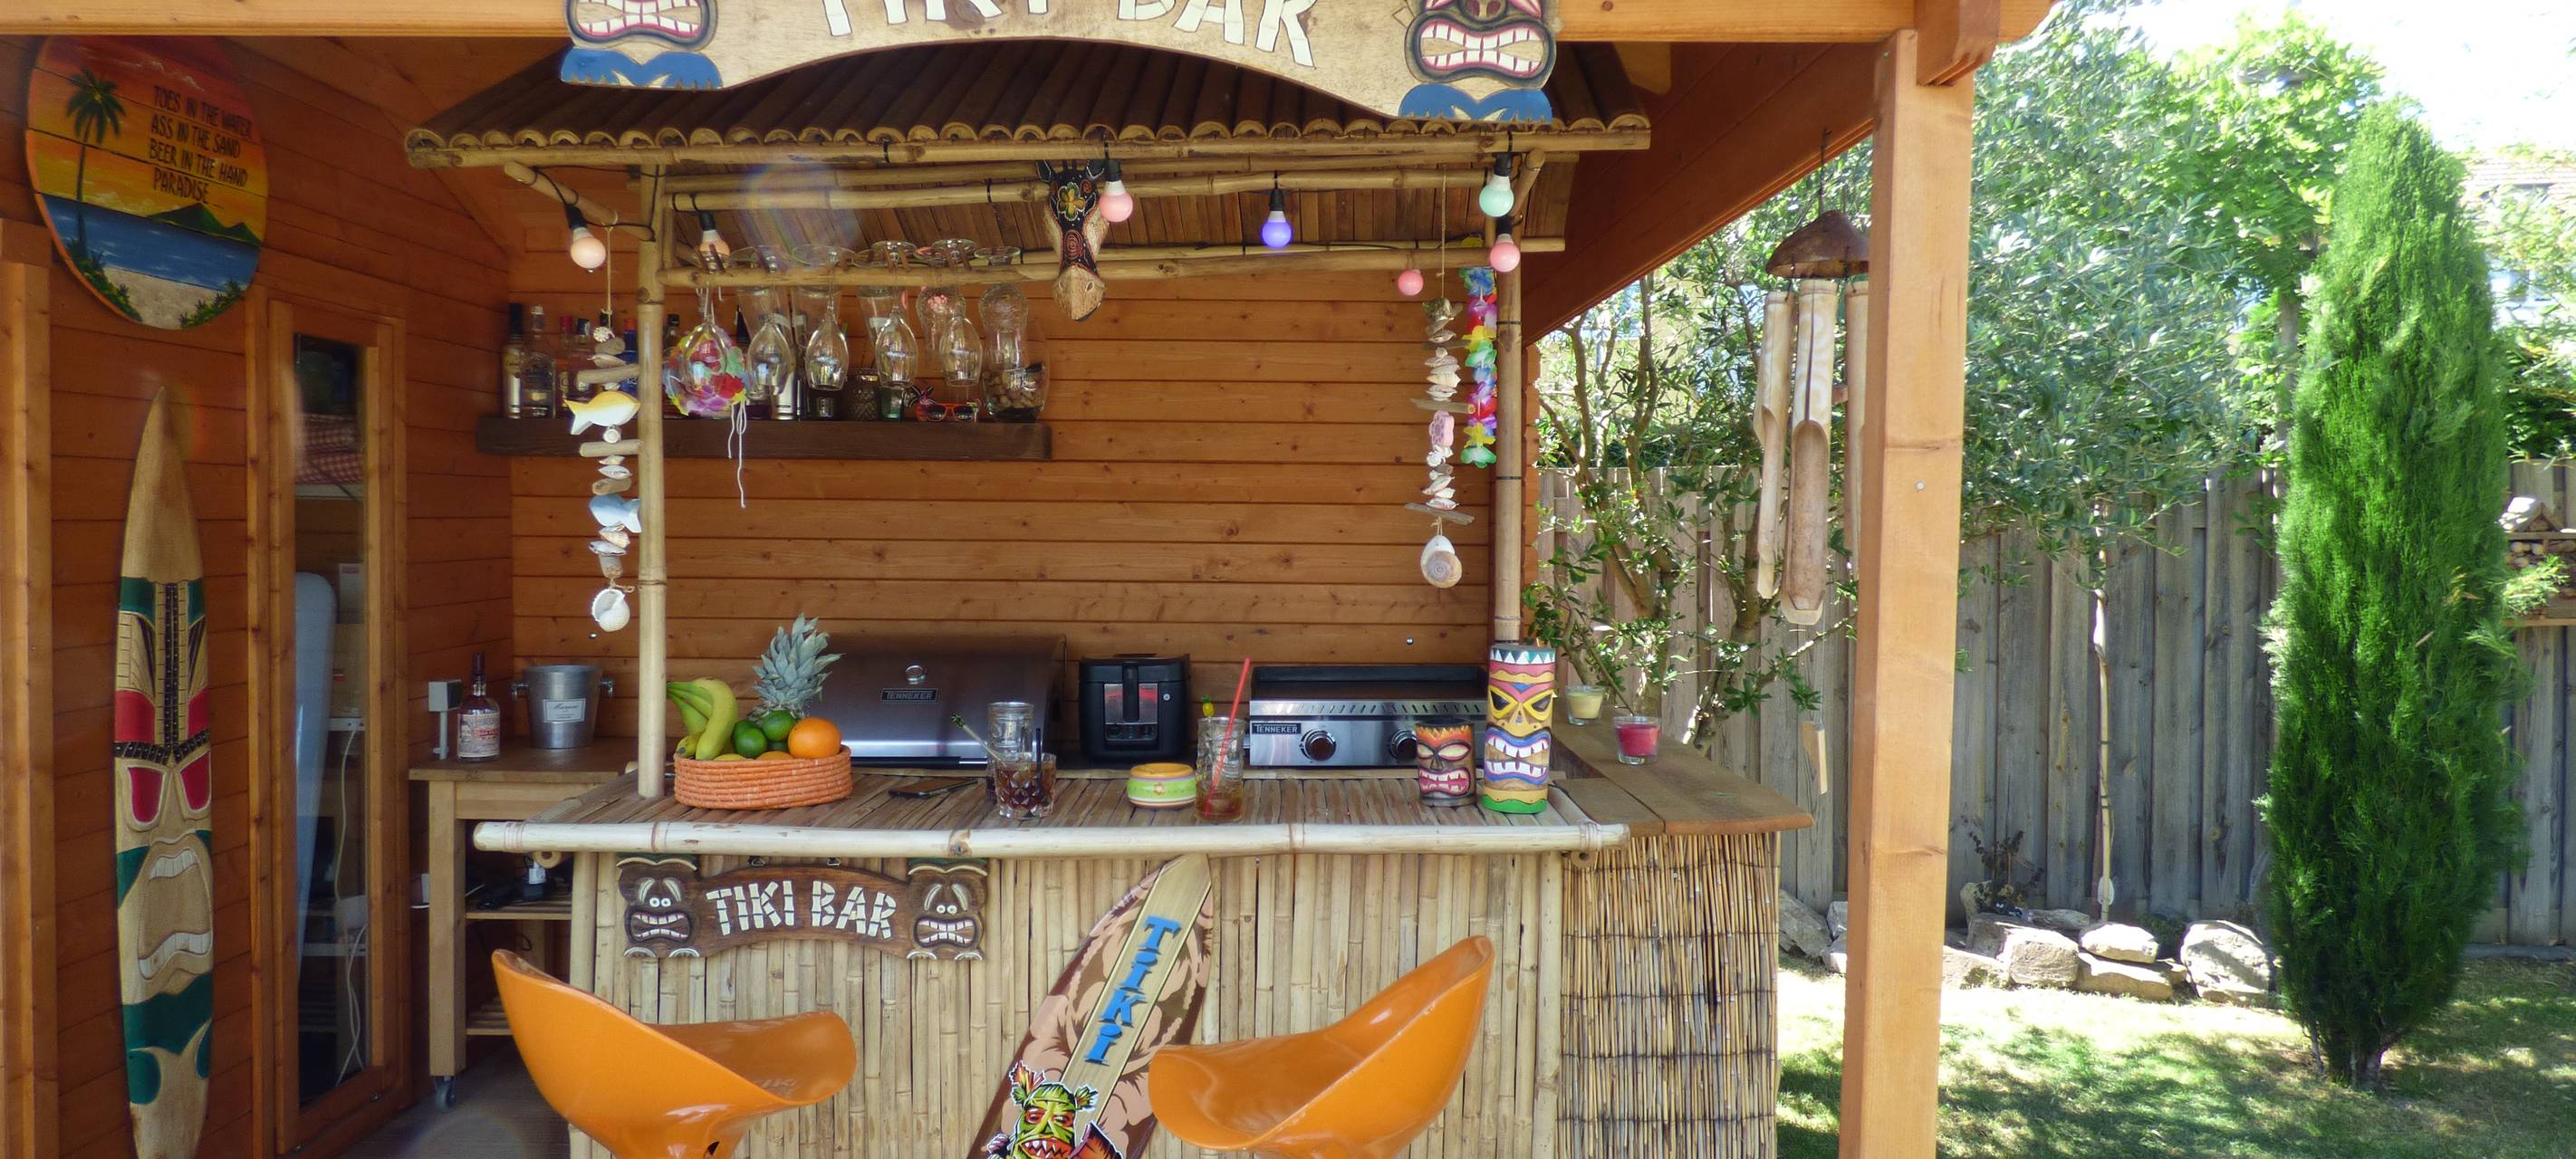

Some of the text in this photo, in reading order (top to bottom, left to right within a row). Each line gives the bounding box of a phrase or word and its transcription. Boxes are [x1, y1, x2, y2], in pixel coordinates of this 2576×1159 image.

[153, 86, 181, 112] TOES
[186, 98, 197, 118] IN
[201, 101, 219, 127] THE
[151, 113, 240, 158] ASS IN THE SAND
[149, 139, 247, 187] BEER IN THE HAND
[1254, 723, 1298, 733] TENNEKER
[706, 880, 897, 939] TIKI BAR
